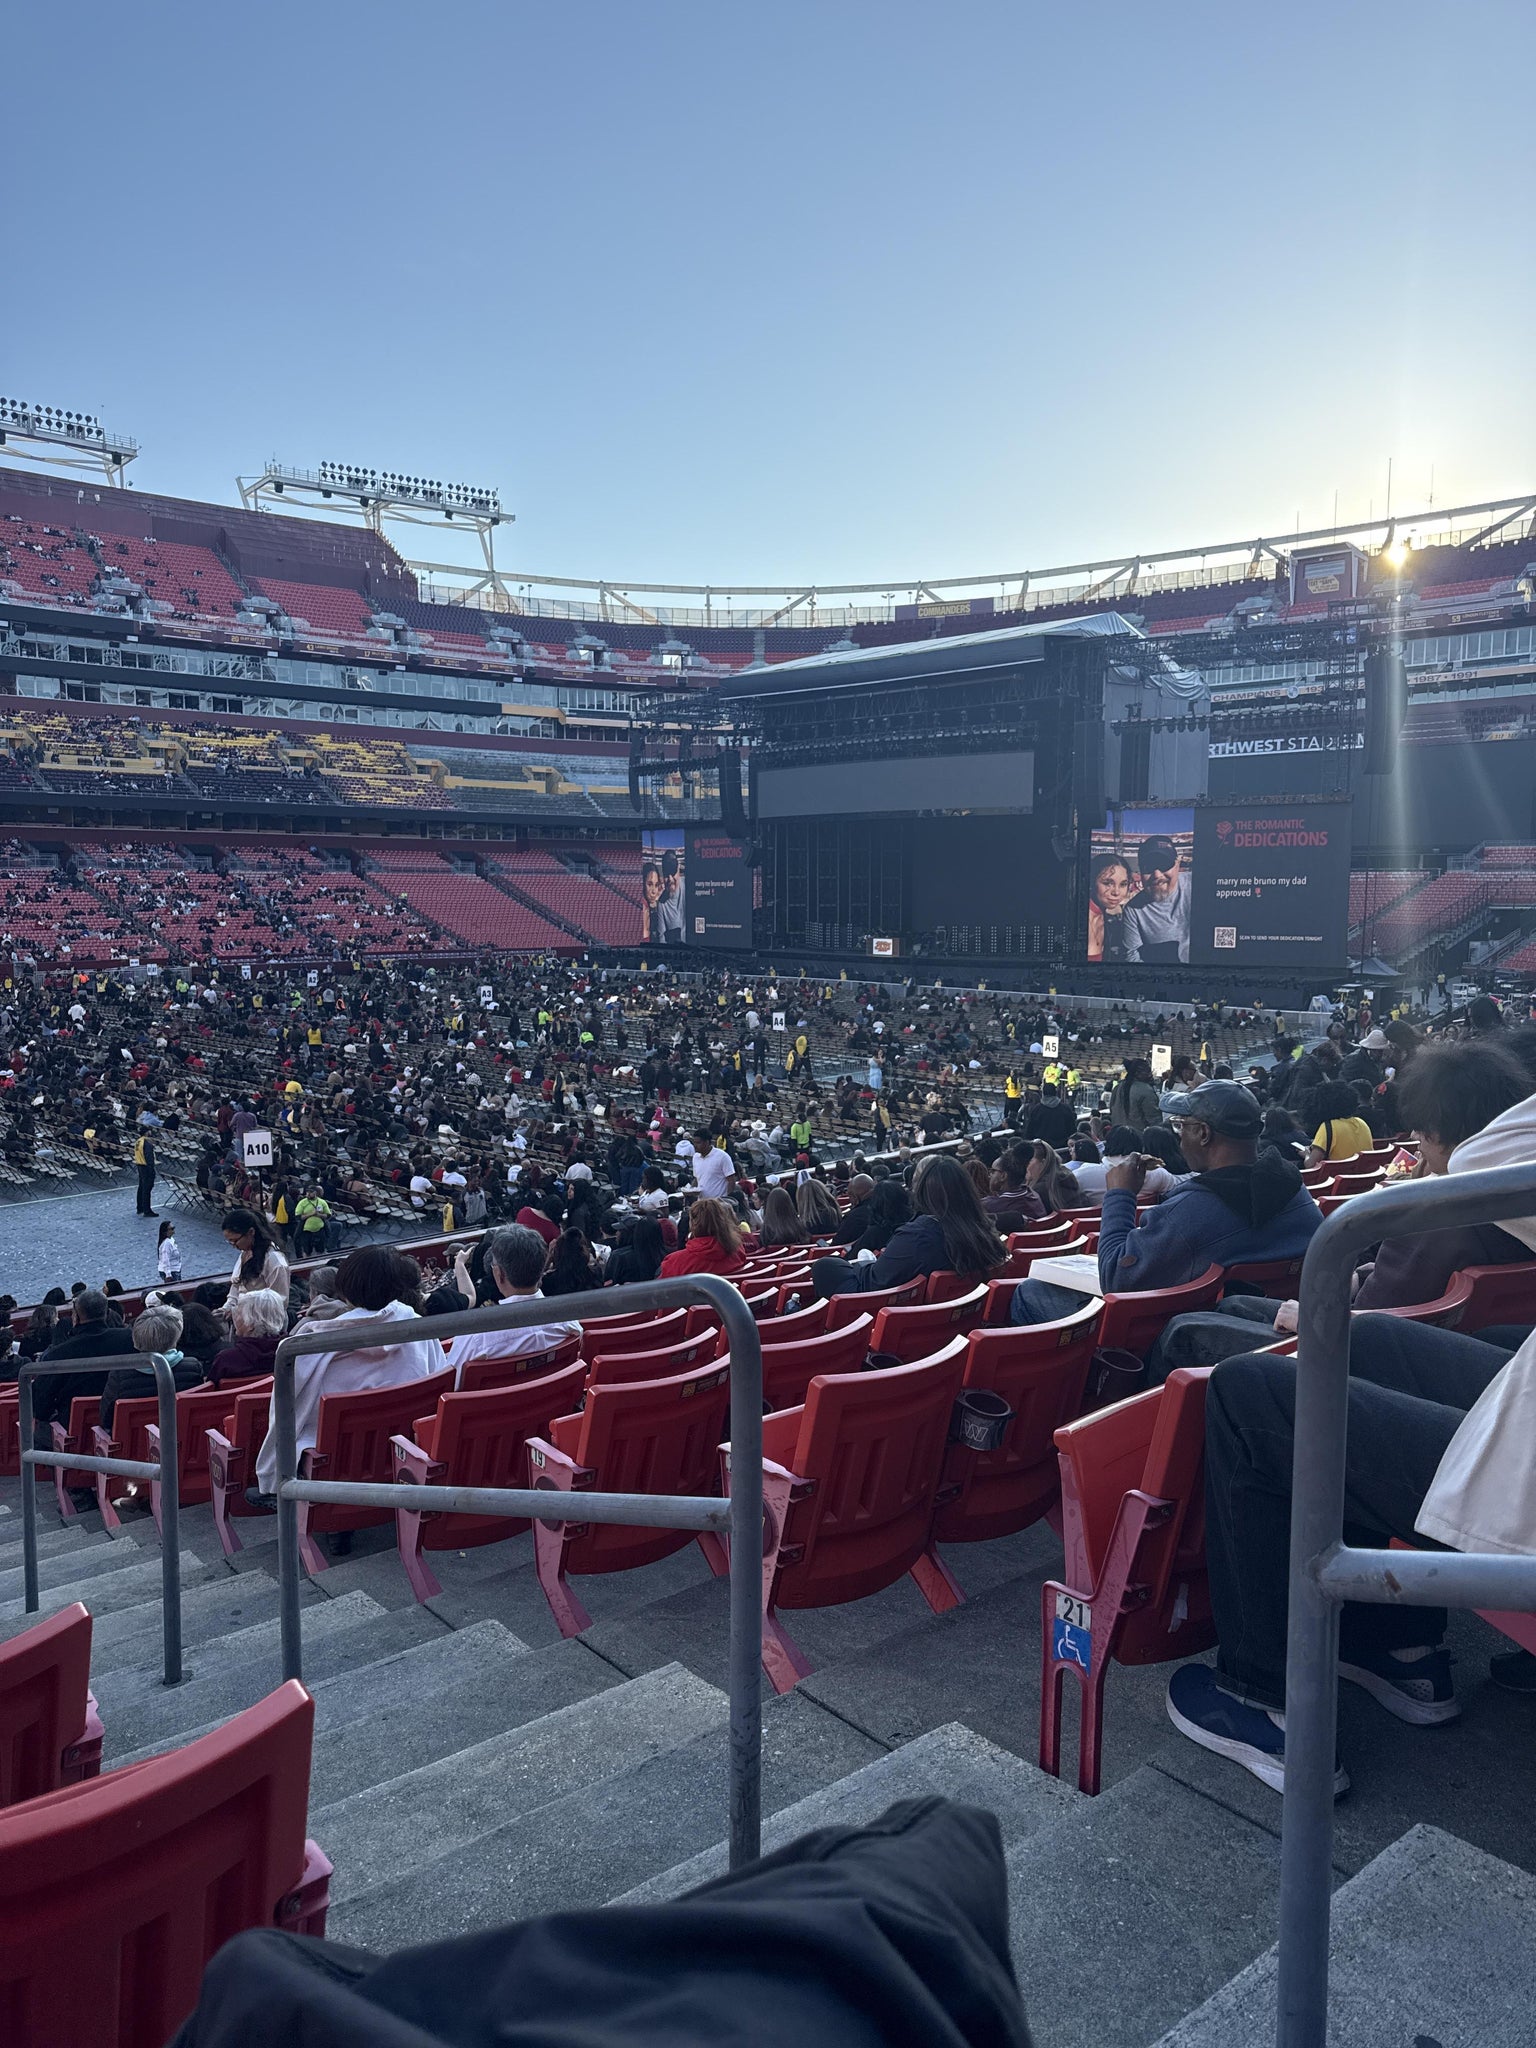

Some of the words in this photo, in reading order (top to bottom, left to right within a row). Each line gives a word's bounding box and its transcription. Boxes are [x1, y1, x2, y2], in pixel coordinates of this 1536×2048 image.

[918, 604, 971, 617] COMMANDERS
[1451, 614, 1461, 622] 59
[1413, 674, 1441, 683] 1987
[1451, 671, 1478, 680] 1991
[1213, 689, 1281, 702] CHAMPIONS
[1235, 820, 1253, 830] THE
[1254, 819, 1305, 830] ROMANTIC
[1234, 831, 1328, 847] DEDICATIONS
[701, 847, 743, 858] DEDICATIONS
[1216, 878, 1239, 888] marry
[1253, 876, 1277, 885] bruno
[1278, 878, 1291, 888] my
[1291, 875, 1307, 885] dad
[1216, 887, 1252, 899] approved
[481, 990, 491, 998] A3
[774, 1017, 784, 1026] A4
[1044, 1042, 1057, 1053] A5
[247, 1143, 270, 1156] A10
[534, 1448, 543, 1467] 19
[1063, 1596, 1084, 1627] 21
